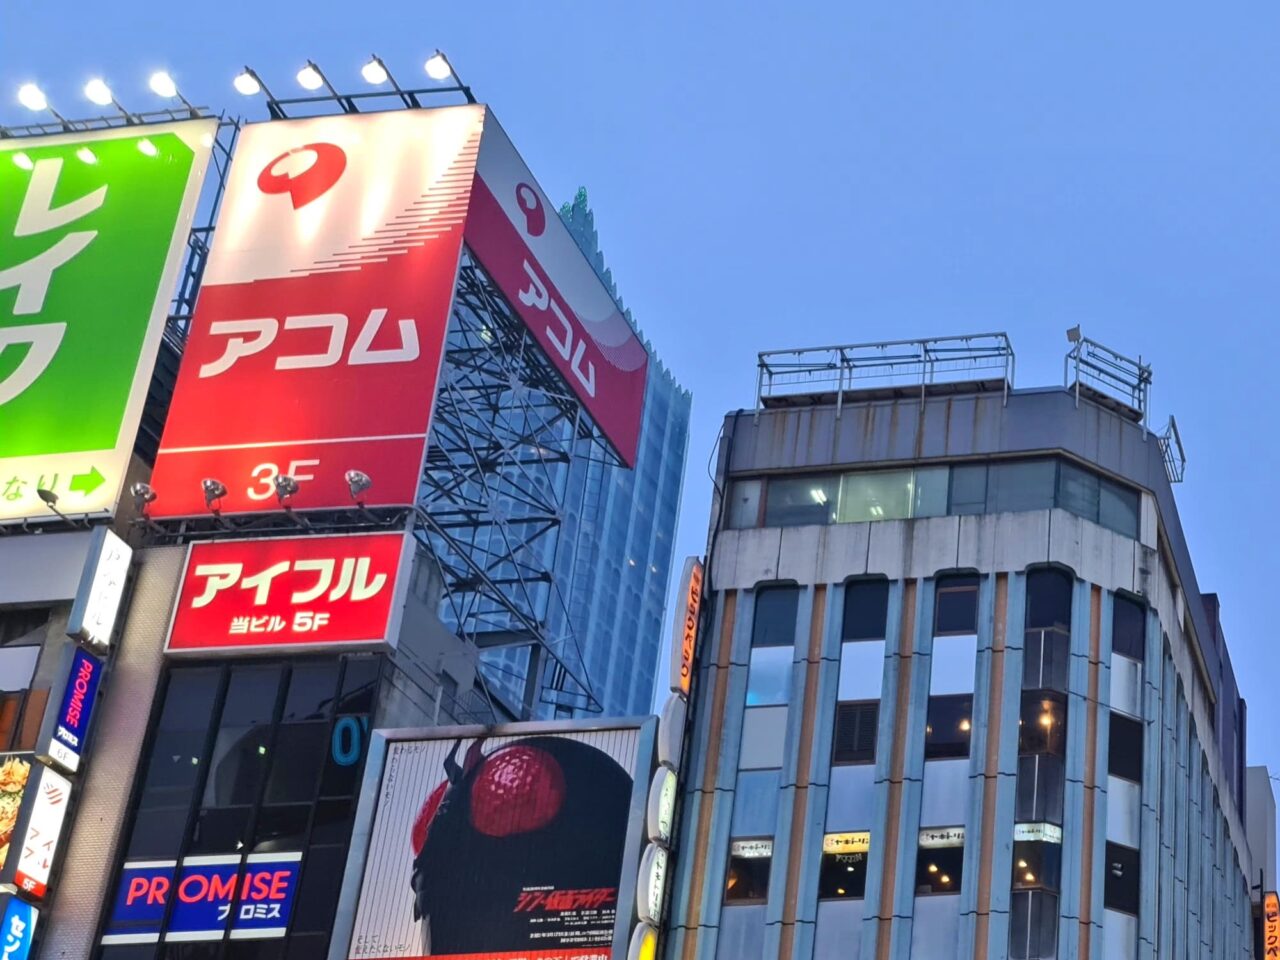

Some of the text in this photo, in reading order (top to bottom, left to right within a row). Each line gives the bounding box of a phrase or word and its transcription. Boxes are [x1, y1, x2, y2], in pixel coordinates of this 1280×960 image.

[199, 309, 421, 378] アコム
[518, 260, 596, 398] アコム
[247, 459, 320, 500] 3F
[192, 557, 387, 608] アイフル
[229, 612, 330, 634] 当ビル 5F
[66, 658, 94, 728] PROMISE
[126, 870, 292, 905] PROMISE
[217, 903, 281, 920] プロミス
